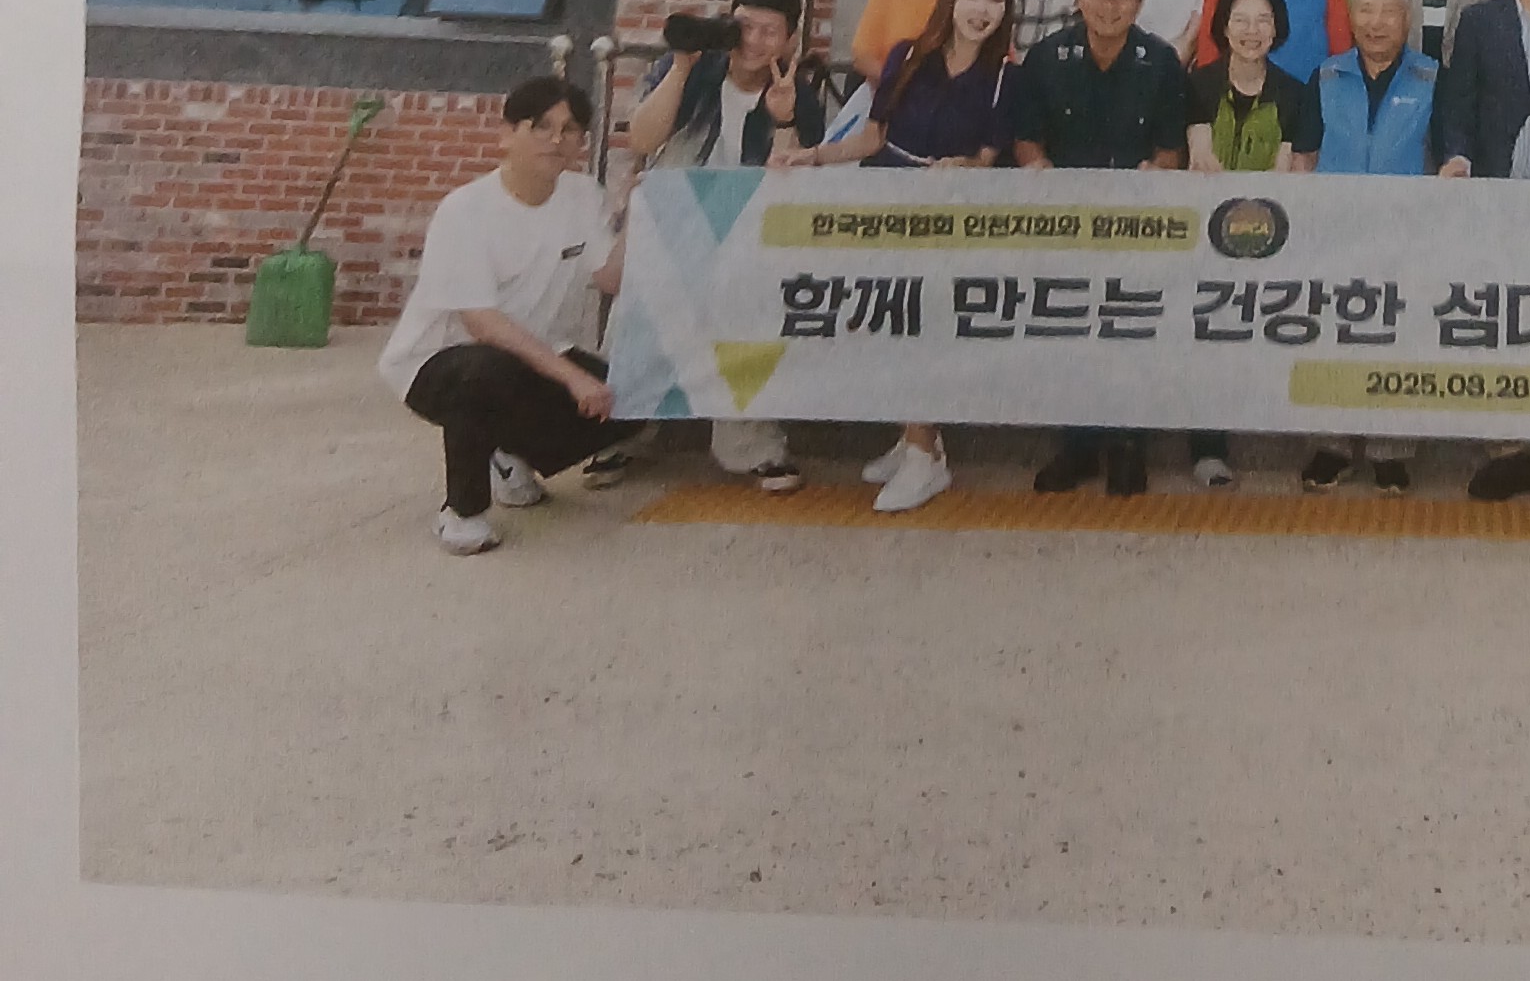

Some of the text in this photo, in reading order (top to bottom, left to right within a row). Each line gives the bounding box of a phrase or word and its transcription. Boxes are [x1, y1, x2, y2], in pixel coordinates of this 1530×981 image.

[812, 213, 1189, 240] 한국방역협회 인천지회와 함께하는
[780, 272, 924, 338] 함께
[953, 276, 1165, 340] 만드는
[1192, 278, 1406, 346] 건강한
